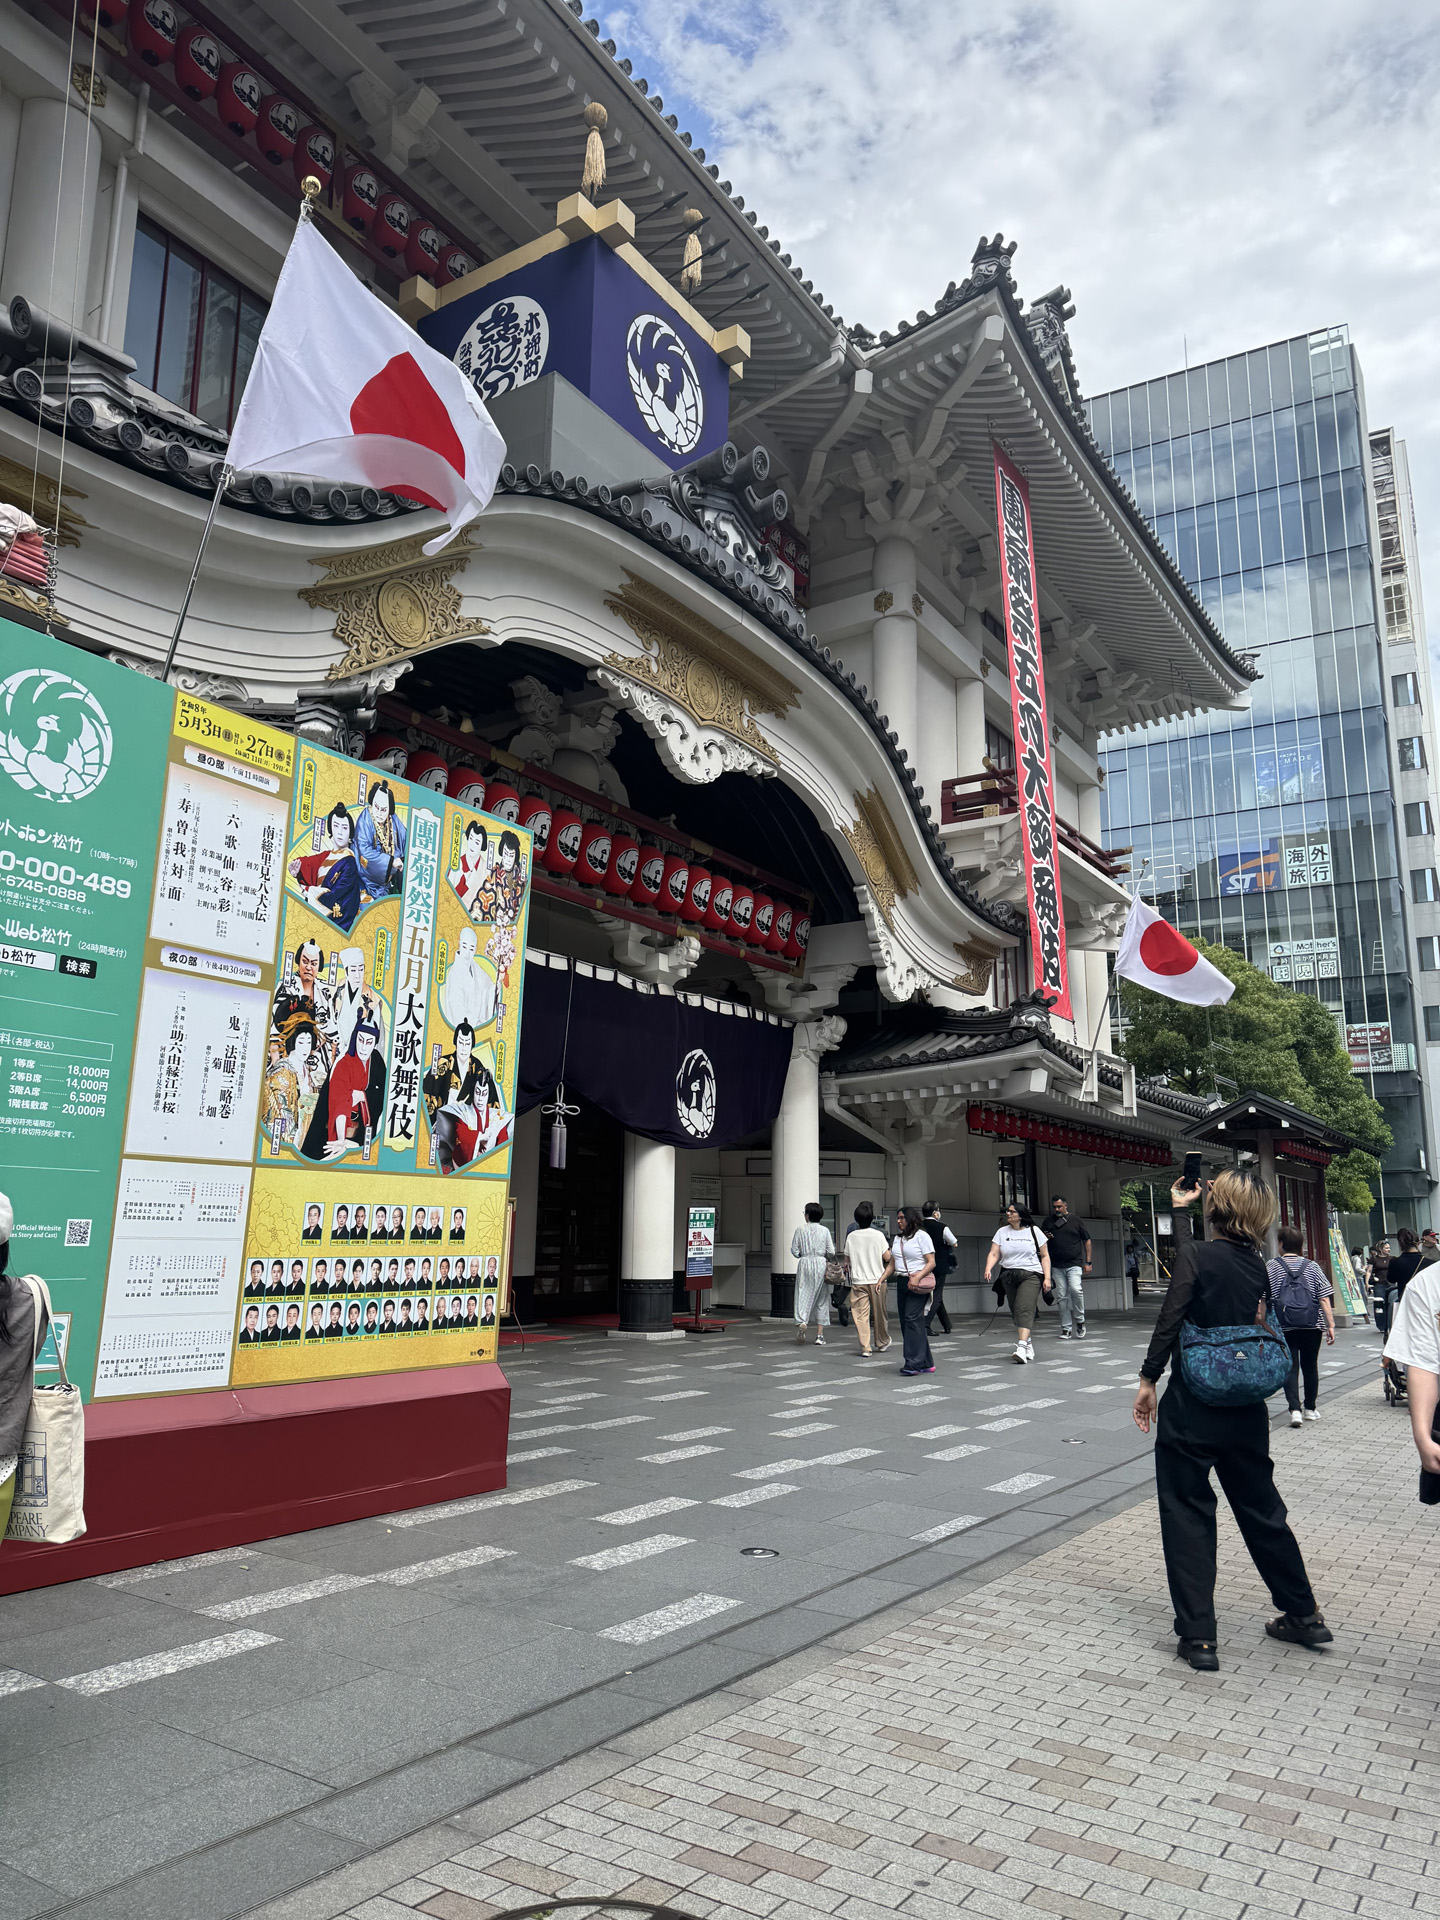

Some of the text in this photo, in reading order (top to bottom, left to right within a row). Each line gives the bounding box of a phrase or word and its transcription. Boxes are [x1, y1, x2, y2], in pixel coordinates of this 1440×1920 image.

[180, 699, 207, 715] 令和8年
[179, 709, 221, 738] 5月3日
[246, 735, 274, 758] 27日
[198, 753, 225, 770] 昼の部
[168, 798, 192, 902] 寿曽我対面
[1288, 845, 1328, 864] 海外
[218, 814, 240, 912] 六歌仙容彩
[255, 825, 275, 922] 南総里見八犬伝
[1289, 866, 1329, 884] 旅行
[0, 873, 87, 903] -6745-0888
[0, 948, 91, 975] b松竹 検索
[169, 952, 257, 978] 夜の部 午後4時30分開演
[388, 814, 437, 1141] 團菊祭五月大歌舞伎
[13, 1058, 110, 1079] 1等席 18,000円
[162, 1030, 184, 1114] 助六由縁江戸桜
[218, 1016, 240, 1119] 鬼一法眼三略巻
[10, 1072, 109, 1092] 2等B席 14,000円
[9, 1085, 107, 1105] 3階A席 6,500円
[62, 1104, 106, 1118] 20,000円
[18, 1232, 33, 1240] Story
[38, 1224, 62, 1232] Website
[8, 1511, 43, 1525] PEARE
